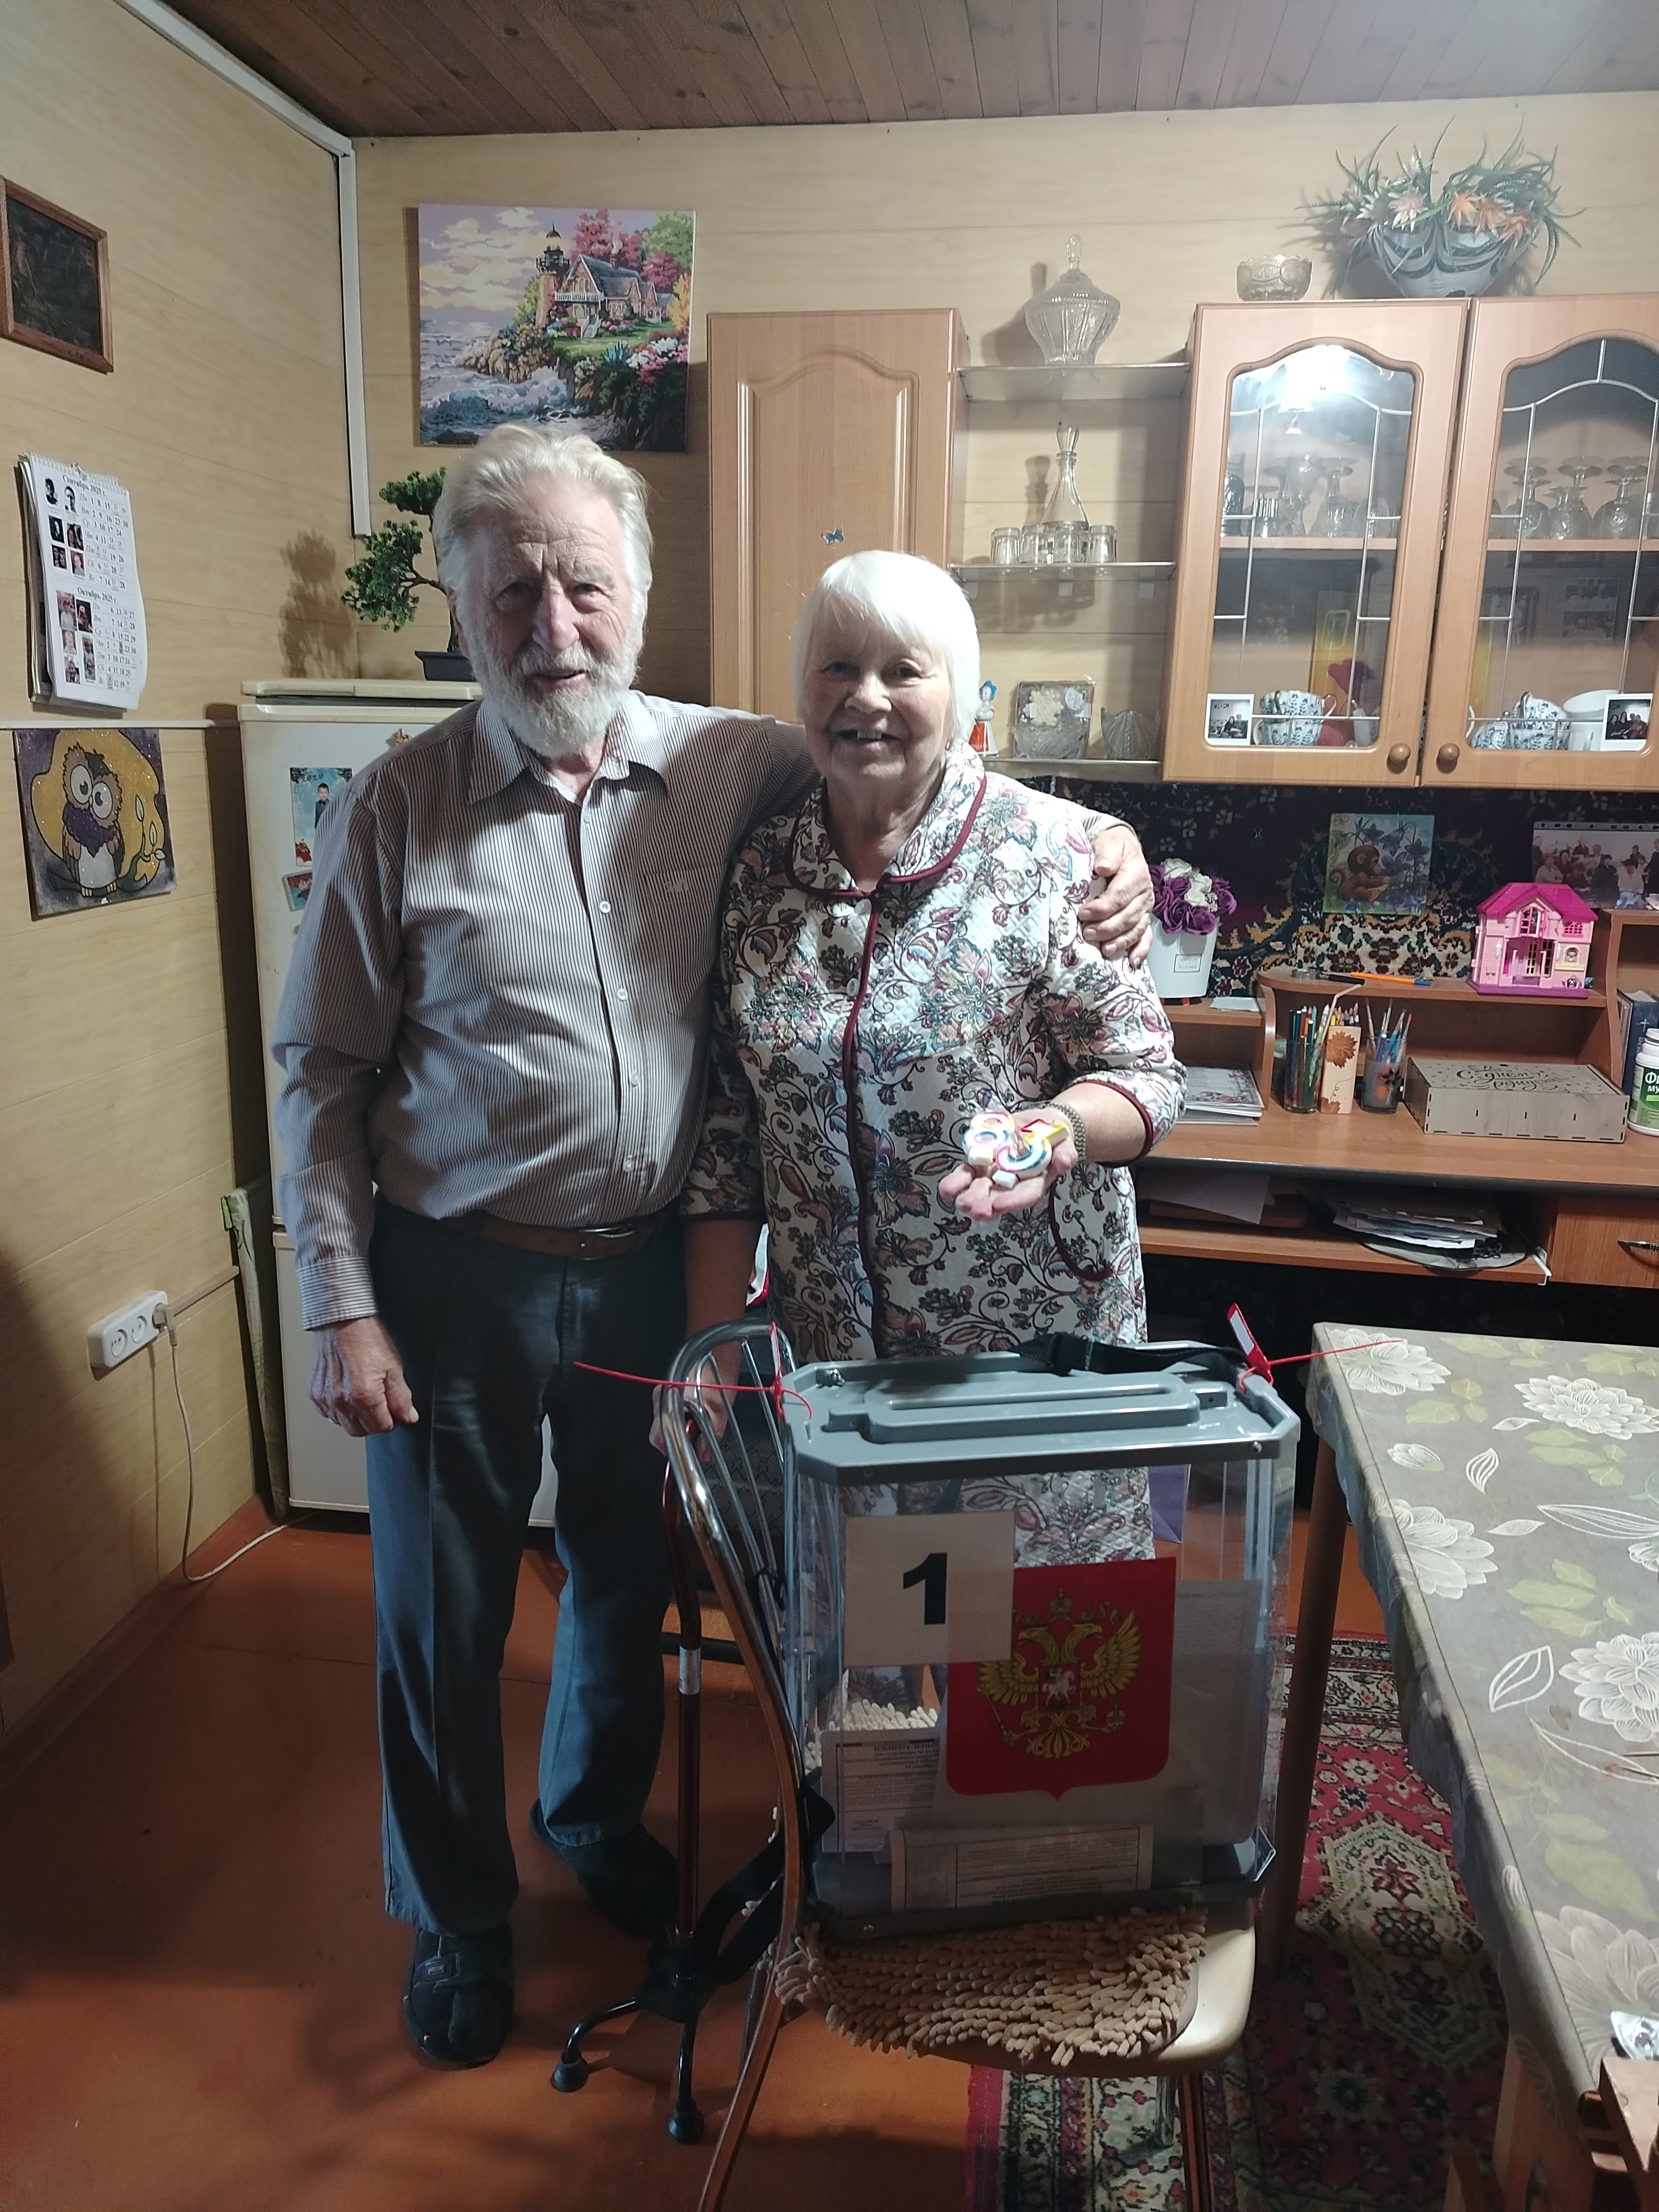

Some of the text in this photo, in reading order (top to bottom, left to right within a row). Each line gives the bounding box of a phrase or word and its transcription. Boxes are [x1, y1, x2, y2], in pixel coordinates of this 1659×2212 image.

[62, 474, 89, 491] Сентябрь
[90, 484, 102, 494] 2025
[80, 493, 87, 502] Пн
[97, 499, 101, 507] 8
[105, 502, 111, 510] 15
[92, 509, 96, 518] 2
[114, 517, 121, 525] 23
[101, 536, 106, 544] 11
[118, 555, 124, 563] 26
[111, 566, 117, 574] 20
[119, 581, 126, 589] 28
[77, 587, 101, 601] Октябрь
[102, 593, 113, 602] 2025
[117, 620, 123, 628] 14
[124, 634, 129, 642] 22
[903, 1553, 947, 1625] 1
